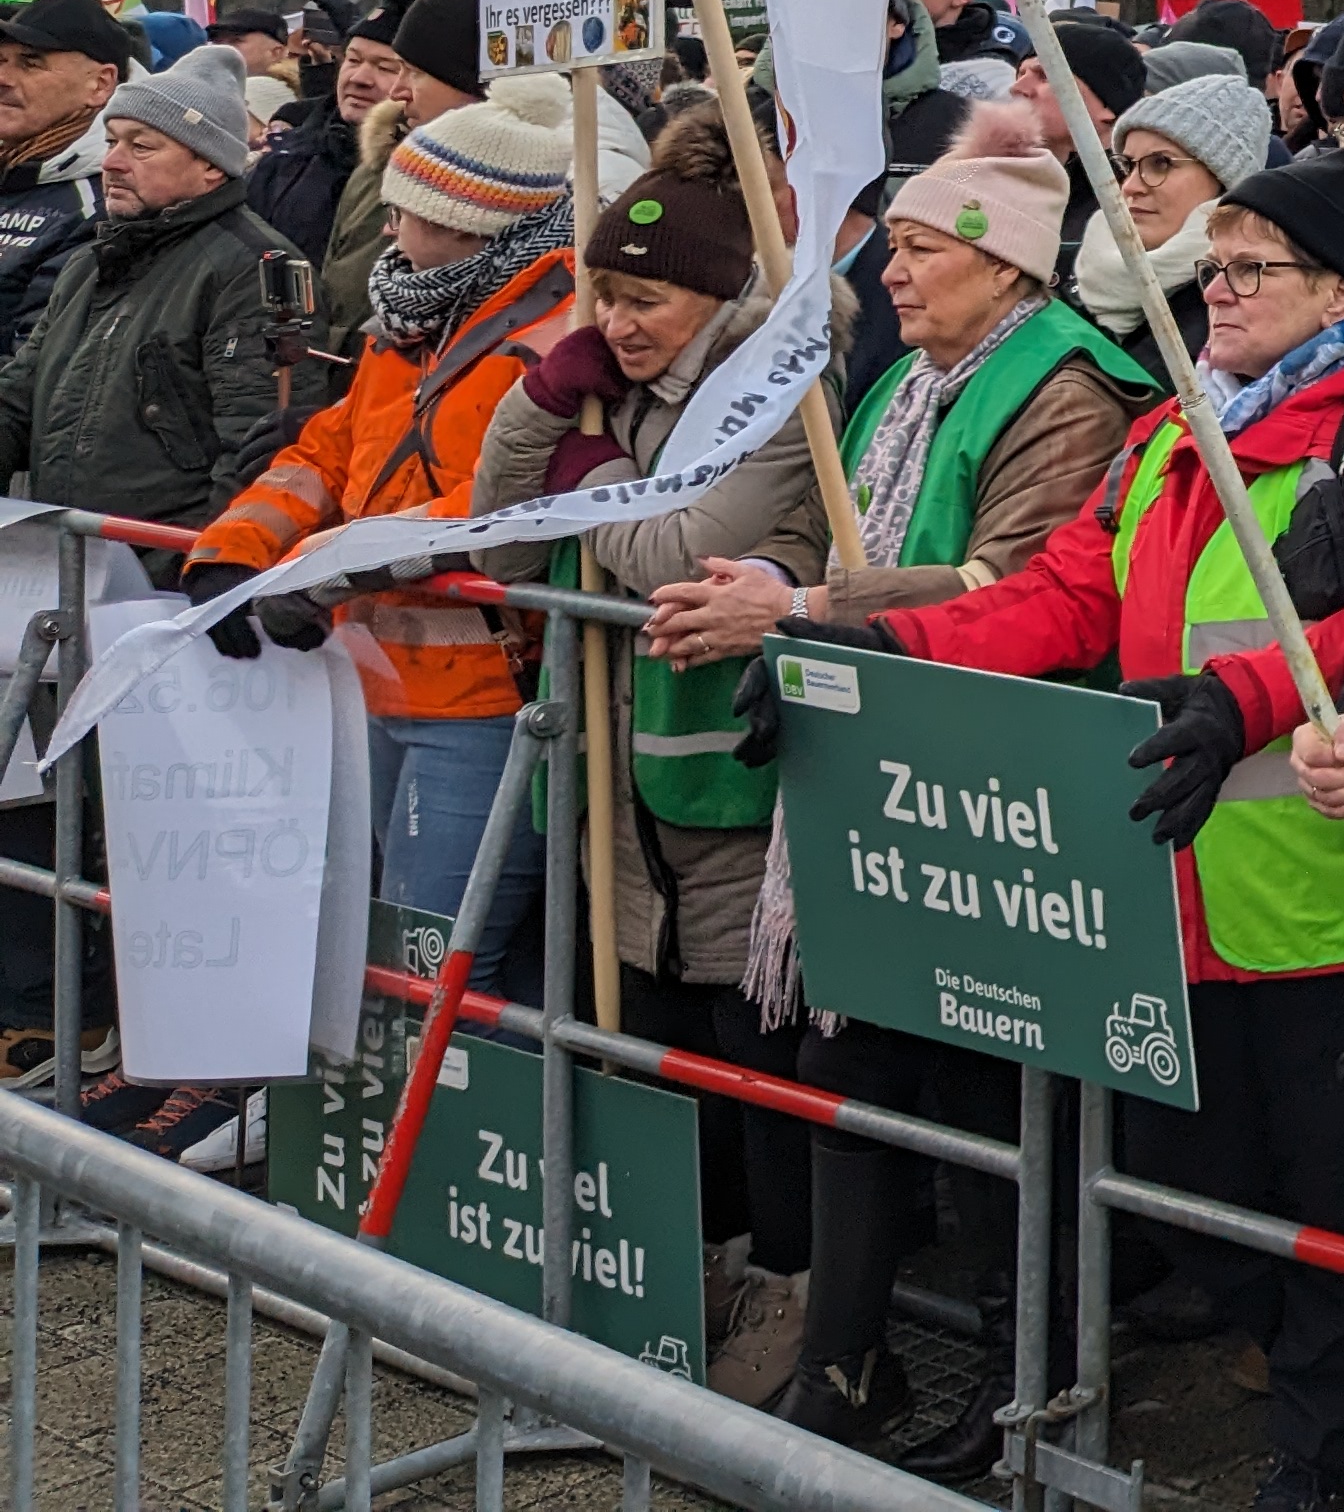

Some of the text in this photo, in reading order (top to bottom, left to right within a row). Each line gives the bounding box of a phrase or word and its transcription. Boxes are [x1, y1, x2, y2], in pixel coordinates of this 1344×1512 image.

[485, 3, 503, 29] Ihr
[505, 7, 520, 26] es
[784, 683, 803, 696] DBV
[879, 759, 1059, 855] Zu viel
[848, 830, 1107, 950] ist zu viel!
[935, 968, 1042, 1011] Die Deutschen
[939, 992, 1045, 1051] Bauern
[318, 1131, 345, 1210] Zu
[477, 1130, 613, 1220] Zu el
[448, 1186, 492, 1250] ist
[502, 1218, 544, 1267] zu
